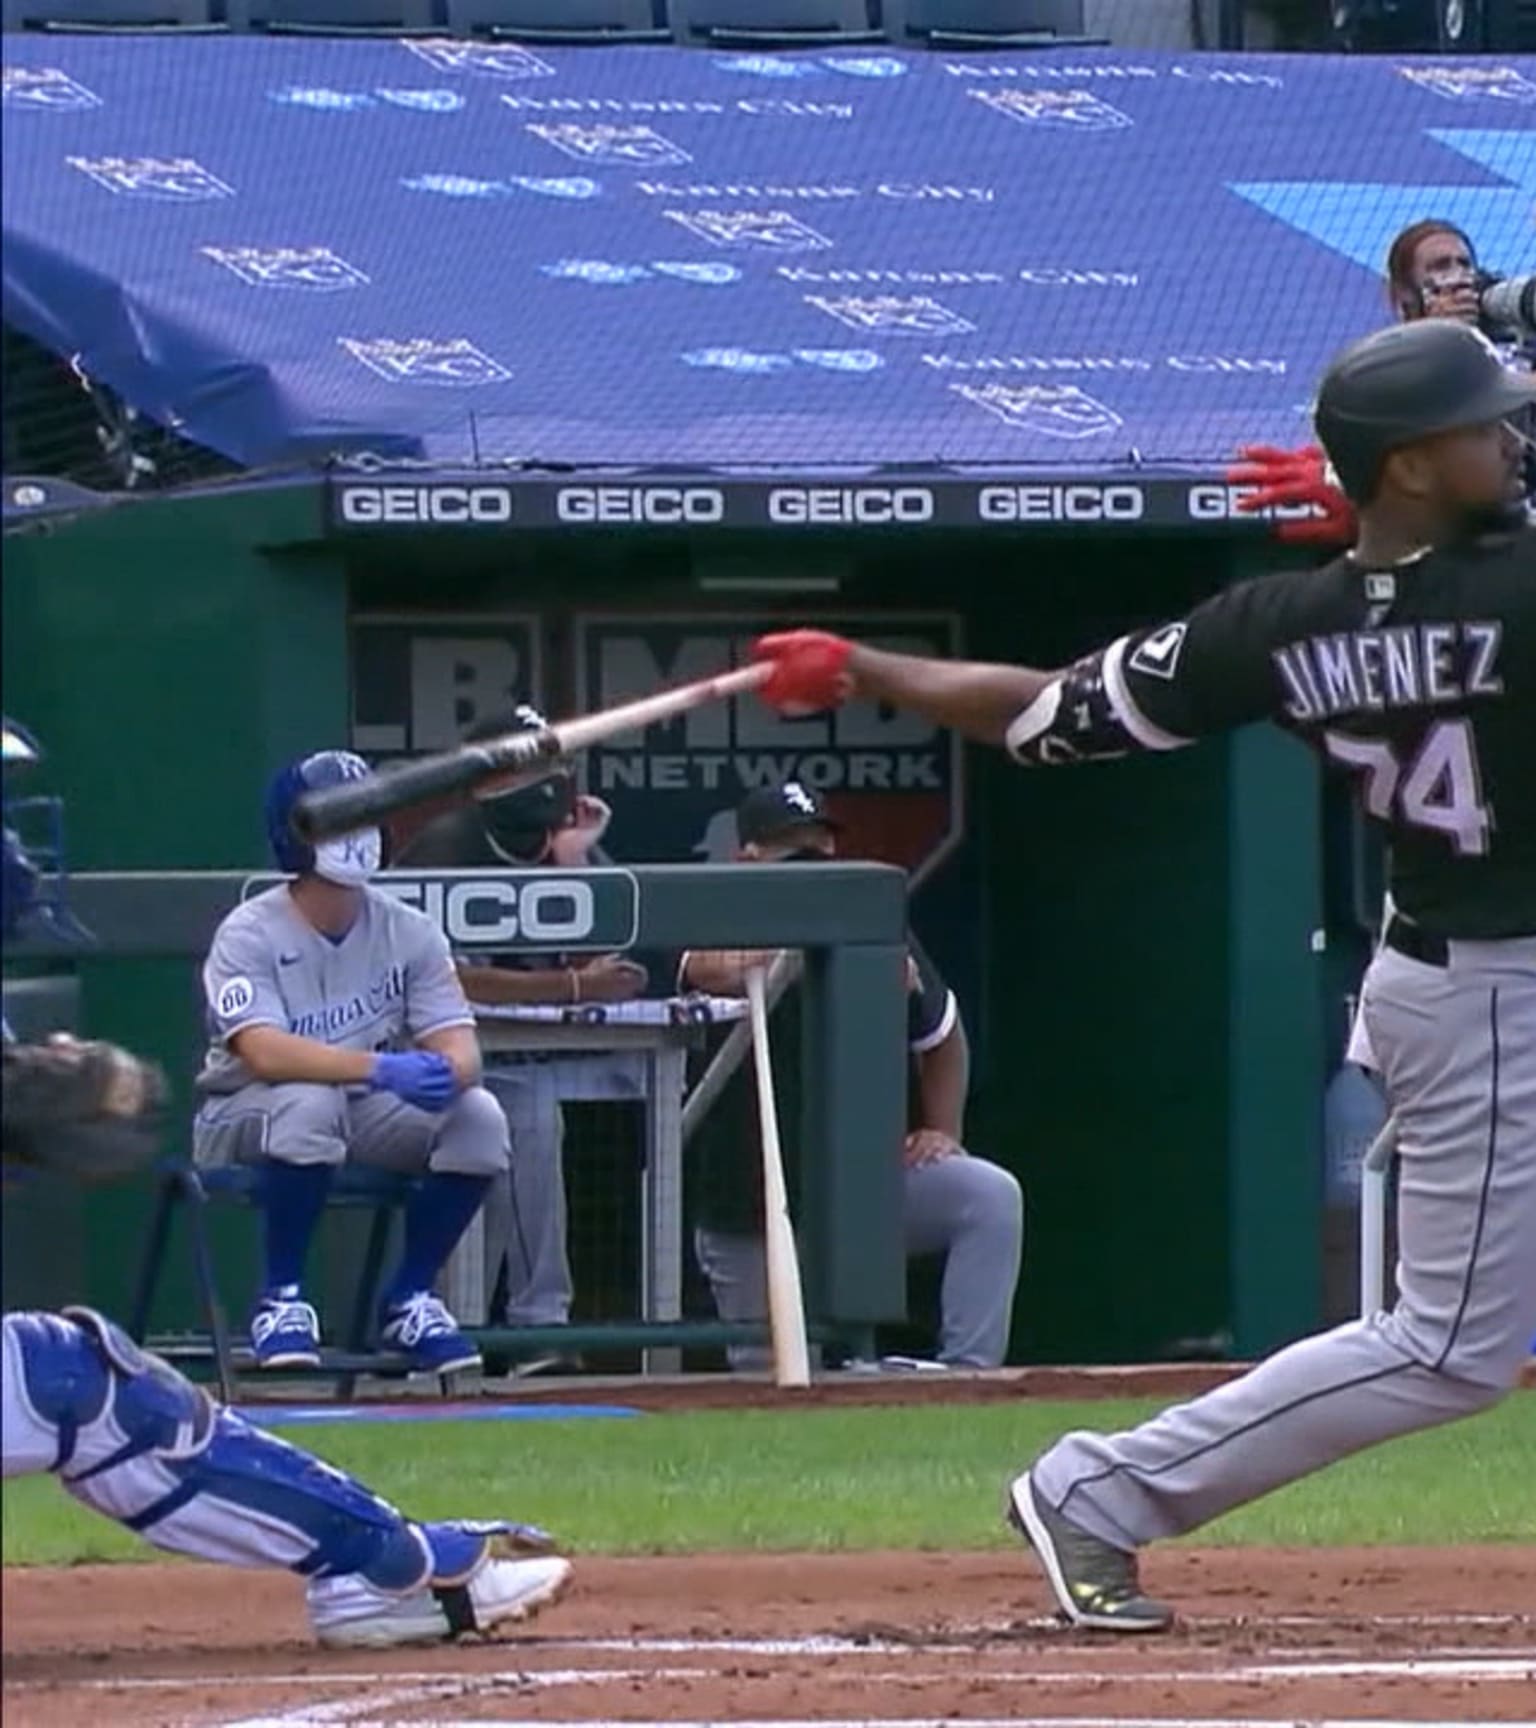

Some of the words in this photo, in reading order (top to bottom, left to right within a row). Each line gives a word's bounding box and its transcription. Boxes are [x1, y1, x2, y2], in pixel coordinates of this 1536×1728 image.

[343, 488, 511, 521] GEICO
[557, 488, 723, 521] GEICO
[769, 488, 933, 522] GEICO
[979, 487, 1143, 520] GEICO
[600, 754, 942, 788] NETWORK
[1324, 717, 1492, 856] 74
[381, 879, 594, 941] ICO
